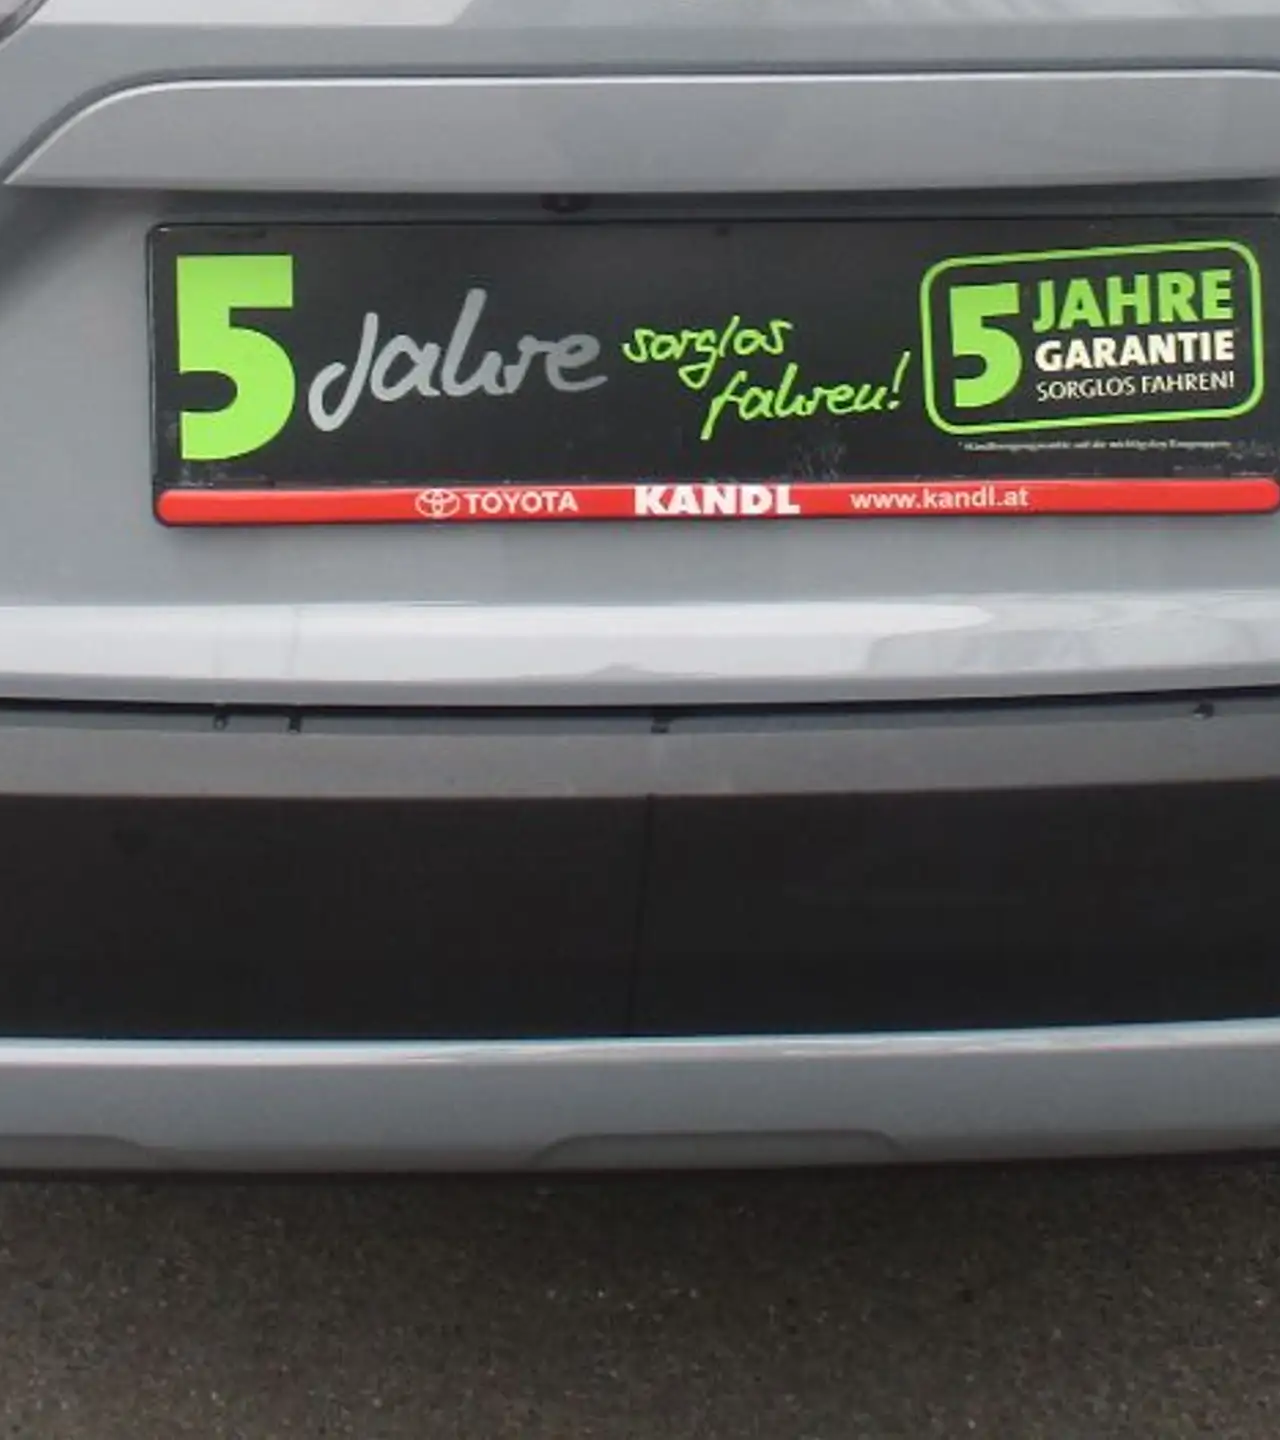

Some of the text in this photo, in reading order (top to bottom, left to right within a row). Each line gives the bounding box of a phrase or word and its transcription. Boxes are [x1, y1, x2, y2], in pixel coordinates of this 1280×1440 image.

[176, 255, 295, 460] 5
[622, 314, 793, 389] sorglos
[949, 268, 1234, 408] 5 JAHRE
[1034, 329, 1234, 372] GARANTIE
[699, 350, 911, 440] fahren!
[1037, 370, 1235, 402] SORGLOS FAHREN!
[465, 484, 1030, 515] TOYOTA KANDL www.kandl.at
